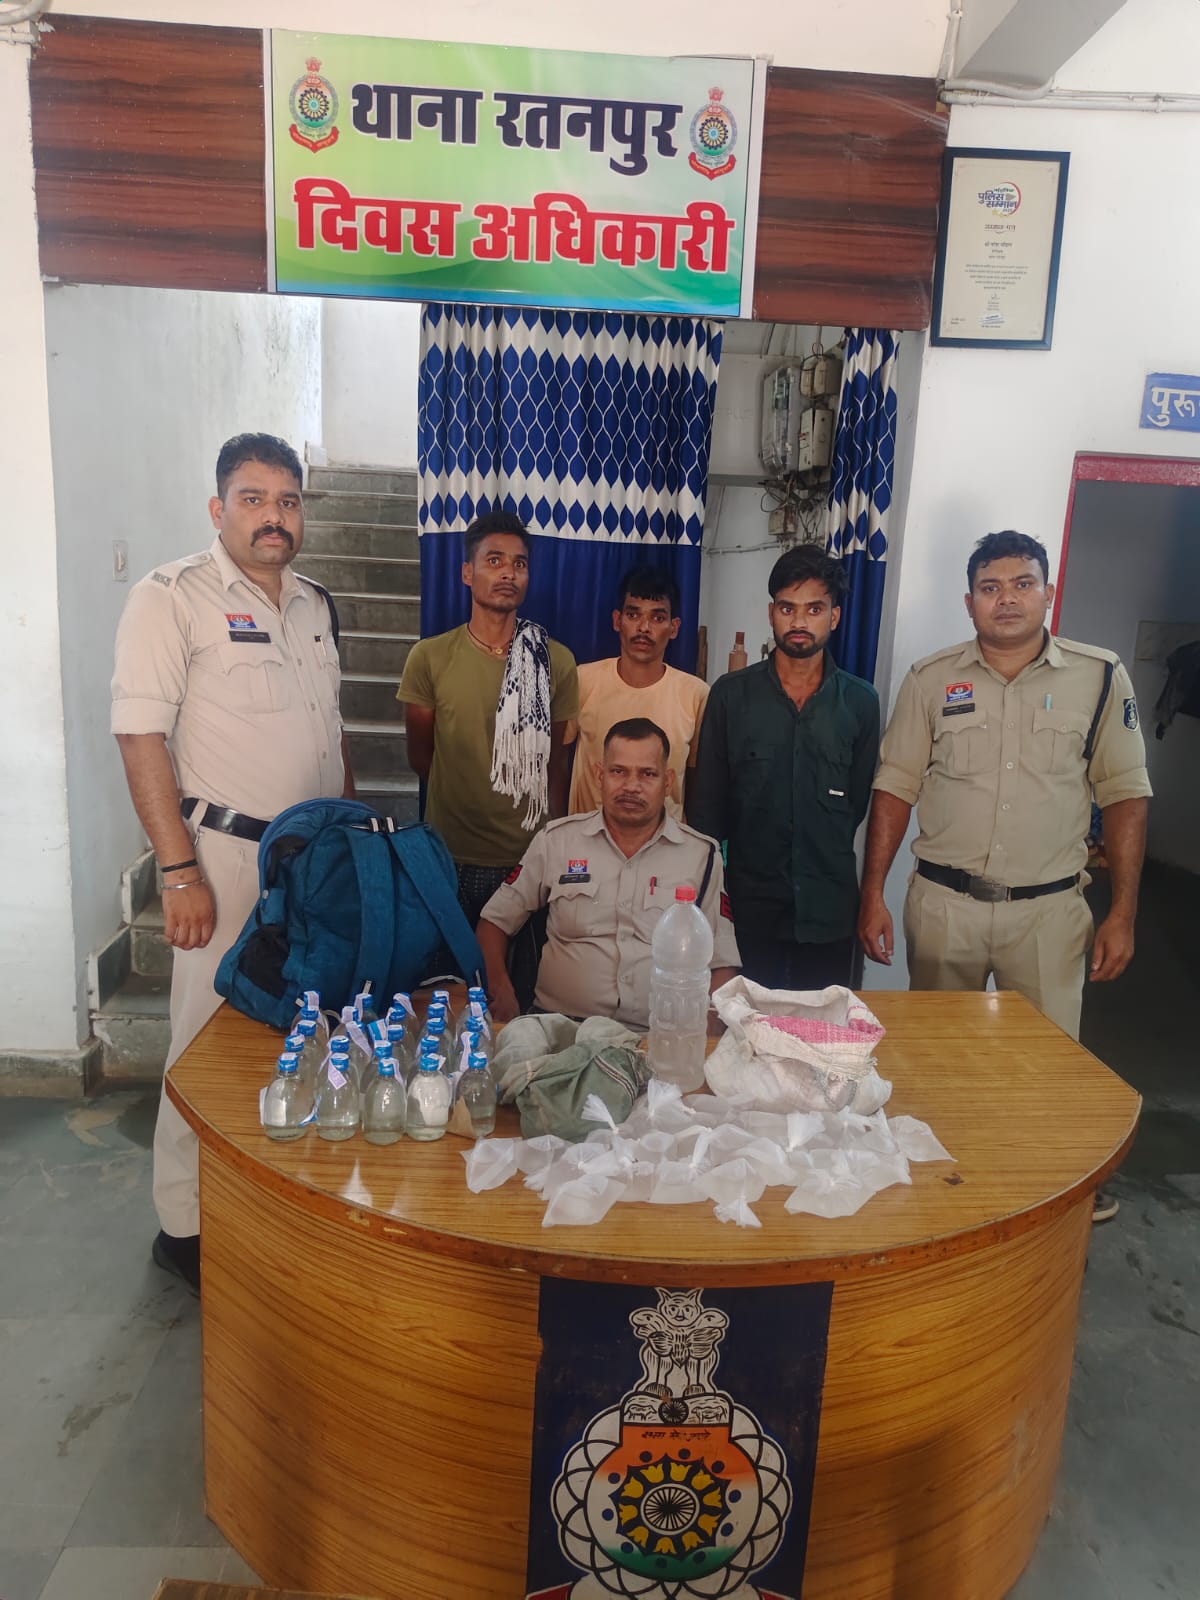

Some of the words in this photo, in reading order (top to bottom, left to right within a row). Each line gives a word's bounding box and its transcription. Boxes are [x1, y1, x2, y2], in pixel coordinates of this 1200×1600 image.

[351, 83, 484, 145] थाना
[493, 92, 684, 176] रतनपुर
[293, 177, 462, 258] दिवस
[471, 192, 736, 273] अधिकारी
[978, 190, 1005, 204] पुलिस
[1146, 386, 1200, 428] पुरू
